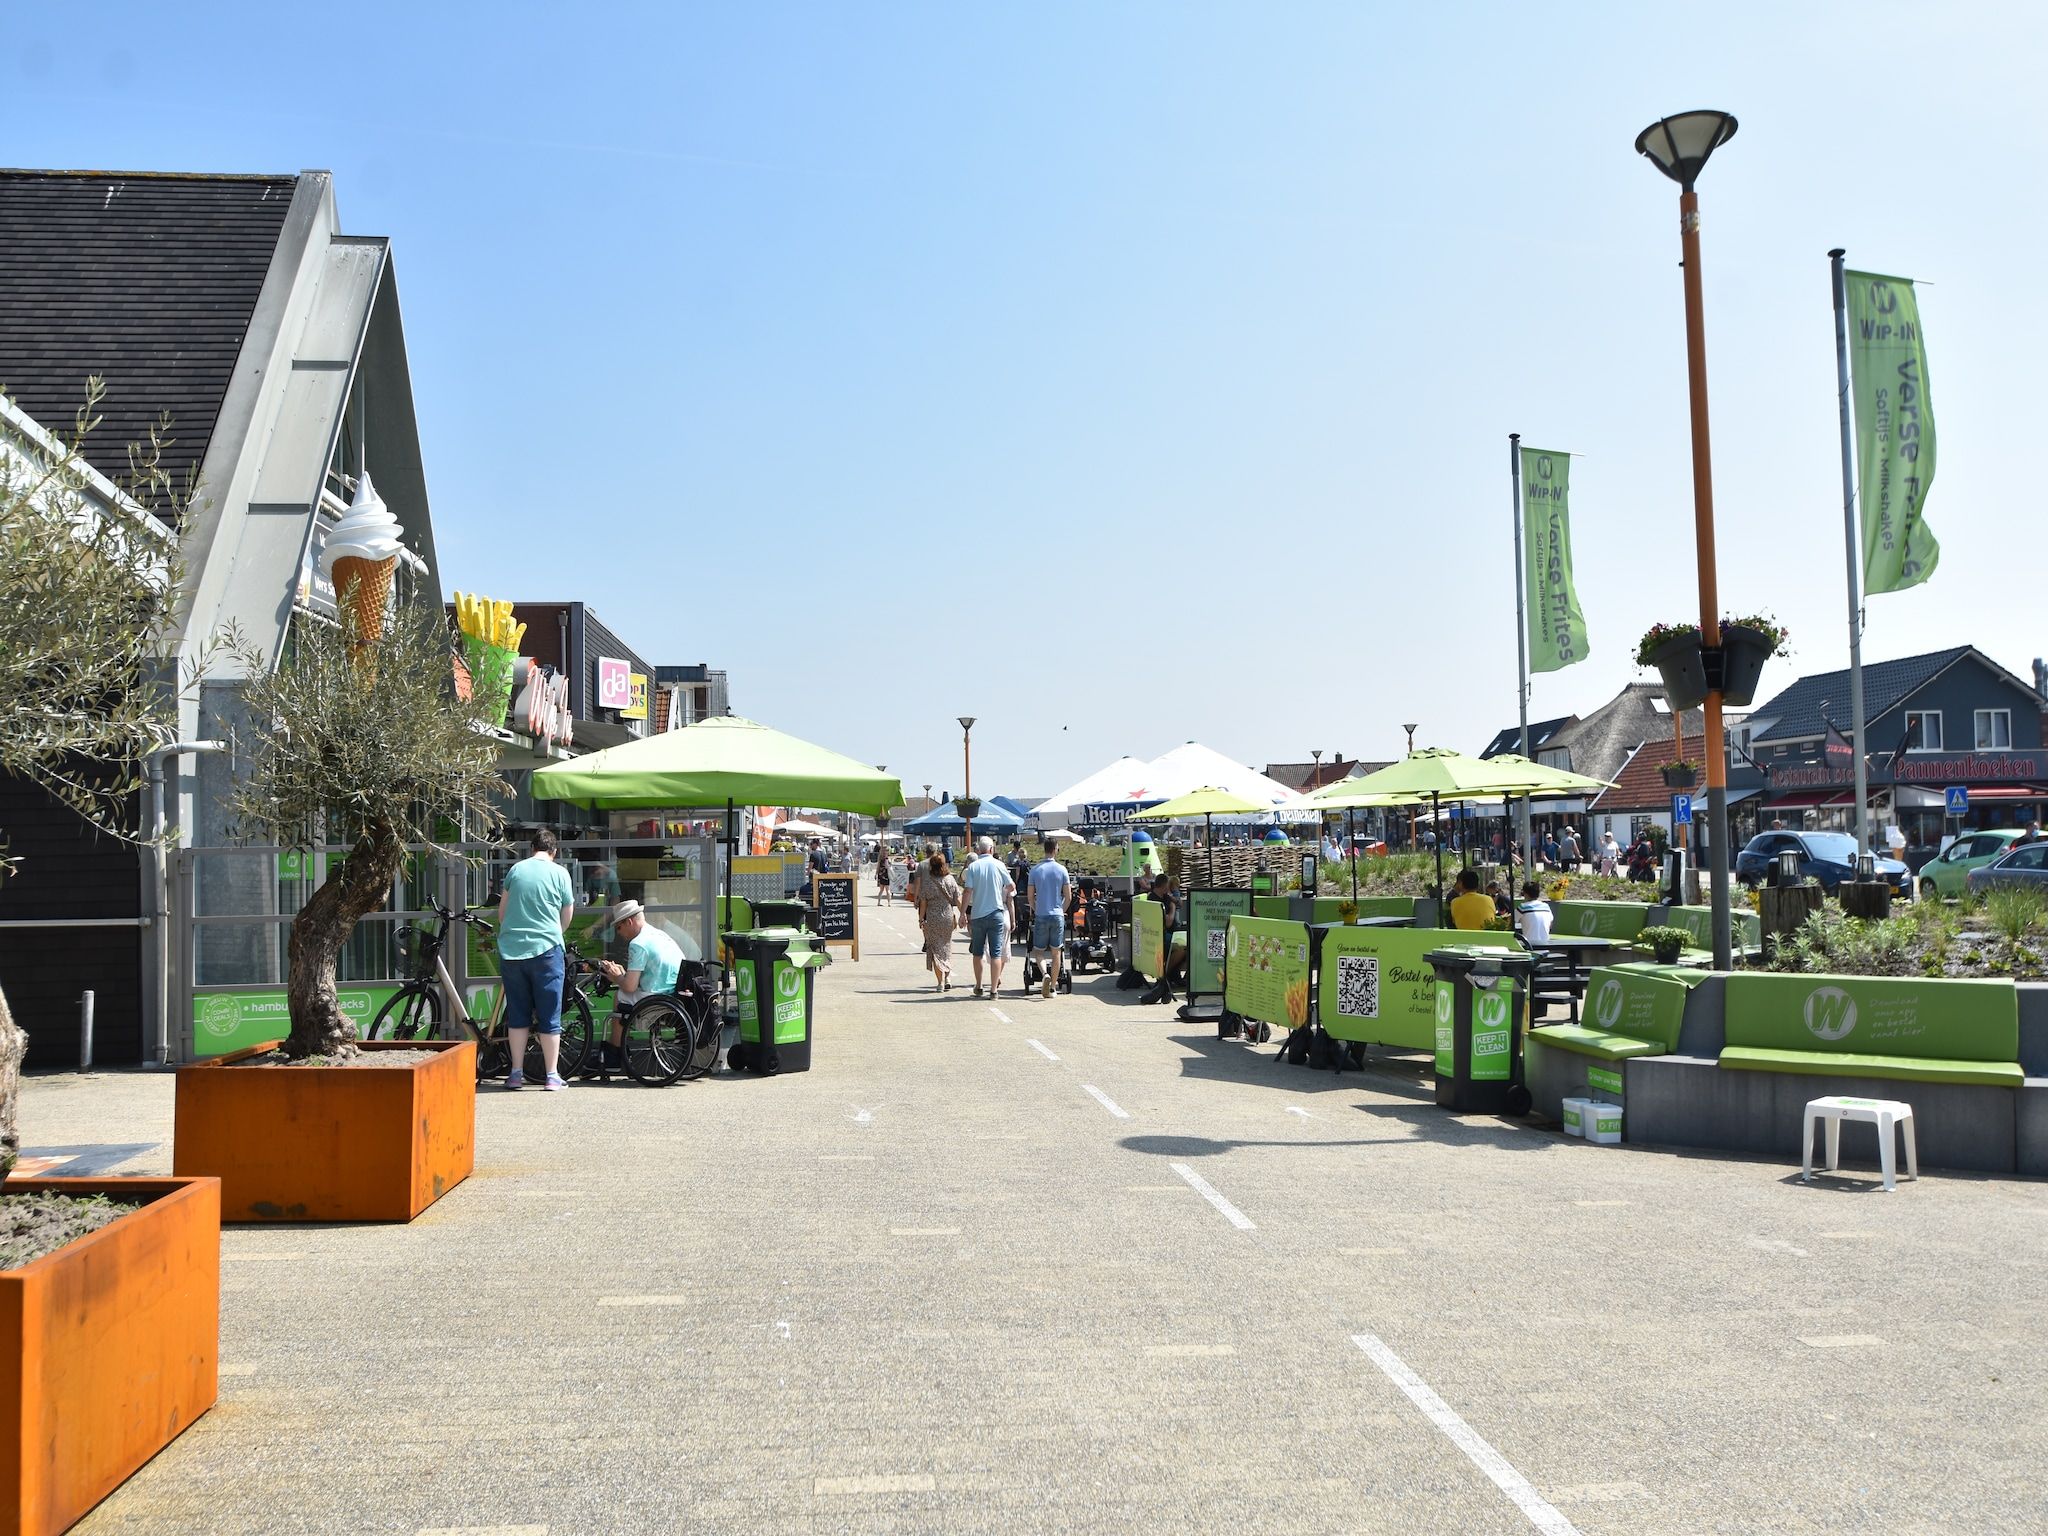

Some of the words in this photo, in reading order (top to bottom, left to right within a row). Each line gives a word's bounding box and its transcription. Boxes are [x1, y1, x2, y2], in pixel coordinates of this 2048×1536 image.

[1876, 388, 1891, 442] Softijs
[1898, 357, 1920, 463] Verse
[1880, 458, 1894, 551] Milkshakes
[1552, 592, 1574, 661] Frites
[603, 668, 626, 698] da
[1895, 755, 2036, 780] Pannenkoeken
[1679, 797, 1688, 811] P
[779, 968, 800, 996] W
[1389, 966, 1421, 984] Bestel
[251, 1003, 288, 1012] hambu
[779, 1003, 794, 1012] KEEP
[779, 1009, 801, 1019] CLEAN
[1479, 994, 1506, 1026] W
[1597, 980, 1623, 1027] W
[1805, 987, 1857, 1040] W
[1869, 996, 1919, 1008] Download
[1476, 1035, 1497, 1044] KEEP
[1498, 1033, 1506, 1041] IT
[1478, 1043, 1505, 1053] CLEAN
